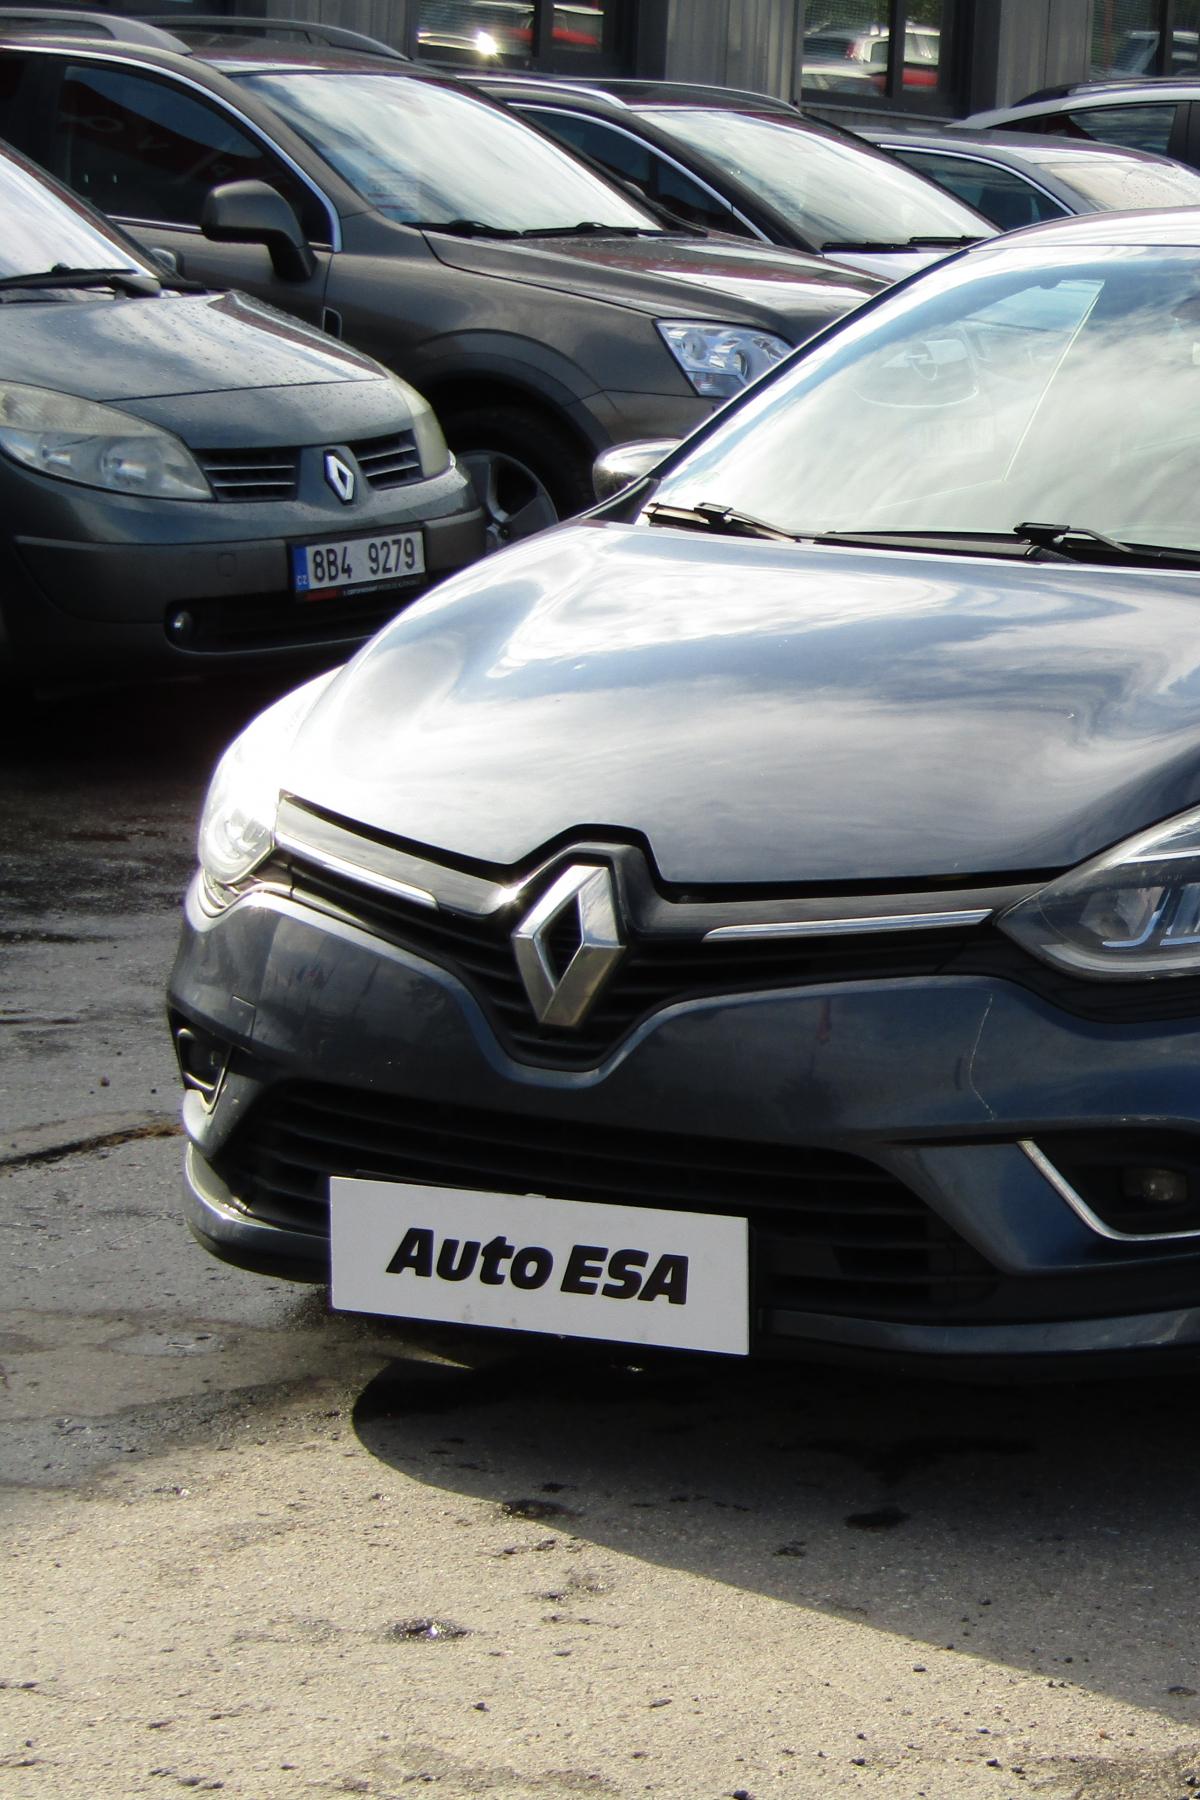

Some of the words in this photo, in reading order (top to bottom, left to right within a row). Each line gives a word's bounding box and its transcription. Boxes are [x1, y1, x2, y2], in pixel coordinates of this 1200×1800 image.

[296, 575, 308, 585] CZ
[313, 546, 352, 582] 8B4
[368, 537, 415, 575] 9279
[385, 1227, 553, 1290] Auto
[560, 1244, 689, 1305] ESA
